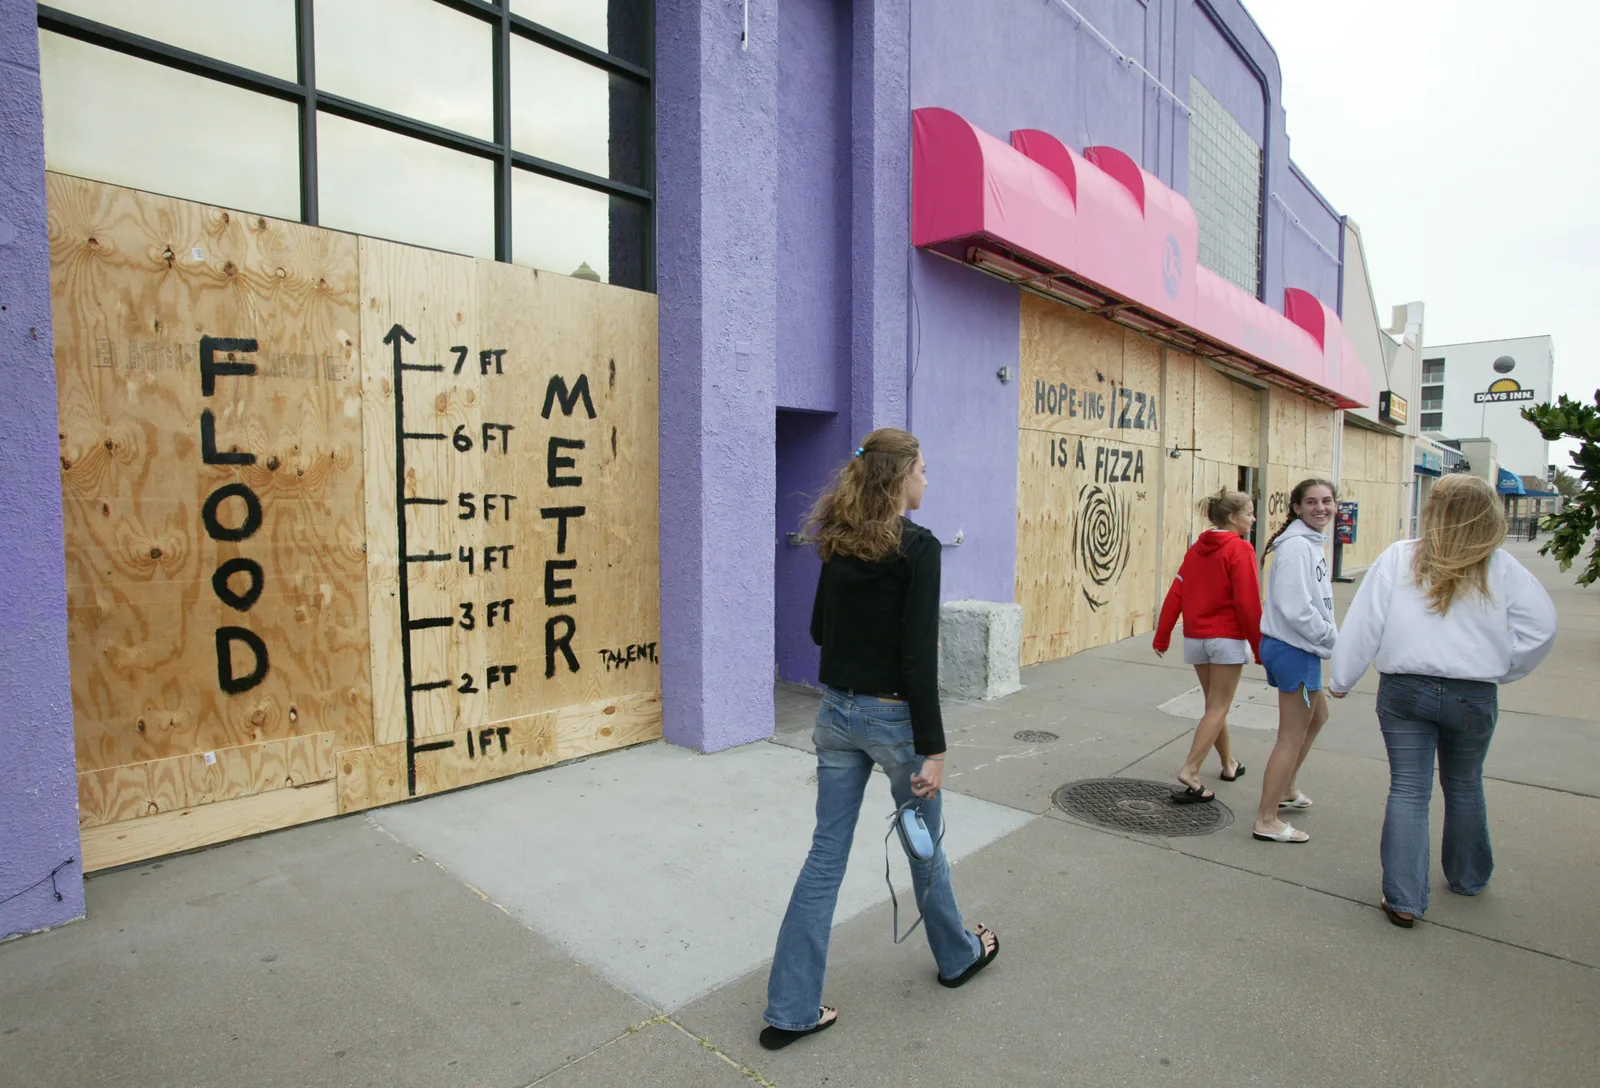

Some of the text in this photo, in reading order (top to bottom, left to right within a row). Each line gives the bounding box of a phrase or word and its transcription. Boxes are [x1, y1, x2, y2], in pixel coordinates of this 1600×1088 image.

[449, 345, 508, 376] 7 FT
[1109, 385, 1158, 431] IZZA
[1476, 393, 1508, 402] DAYS
[452, 422, 516, 455] 6 FT
[1050, 437, 1144, 484] IS A FIZZA
[200, 334, 270, 694] FLOOD
[457, 492, 518, 522] 5 FT
[540, 373, 598, 680] METER
[458, 544, 515, 576] 4 FT
[458, 598, 515, 632] 3 FT
[456, 664, 518, 694] 2 FT
[478, 726, 511, 757] FT
